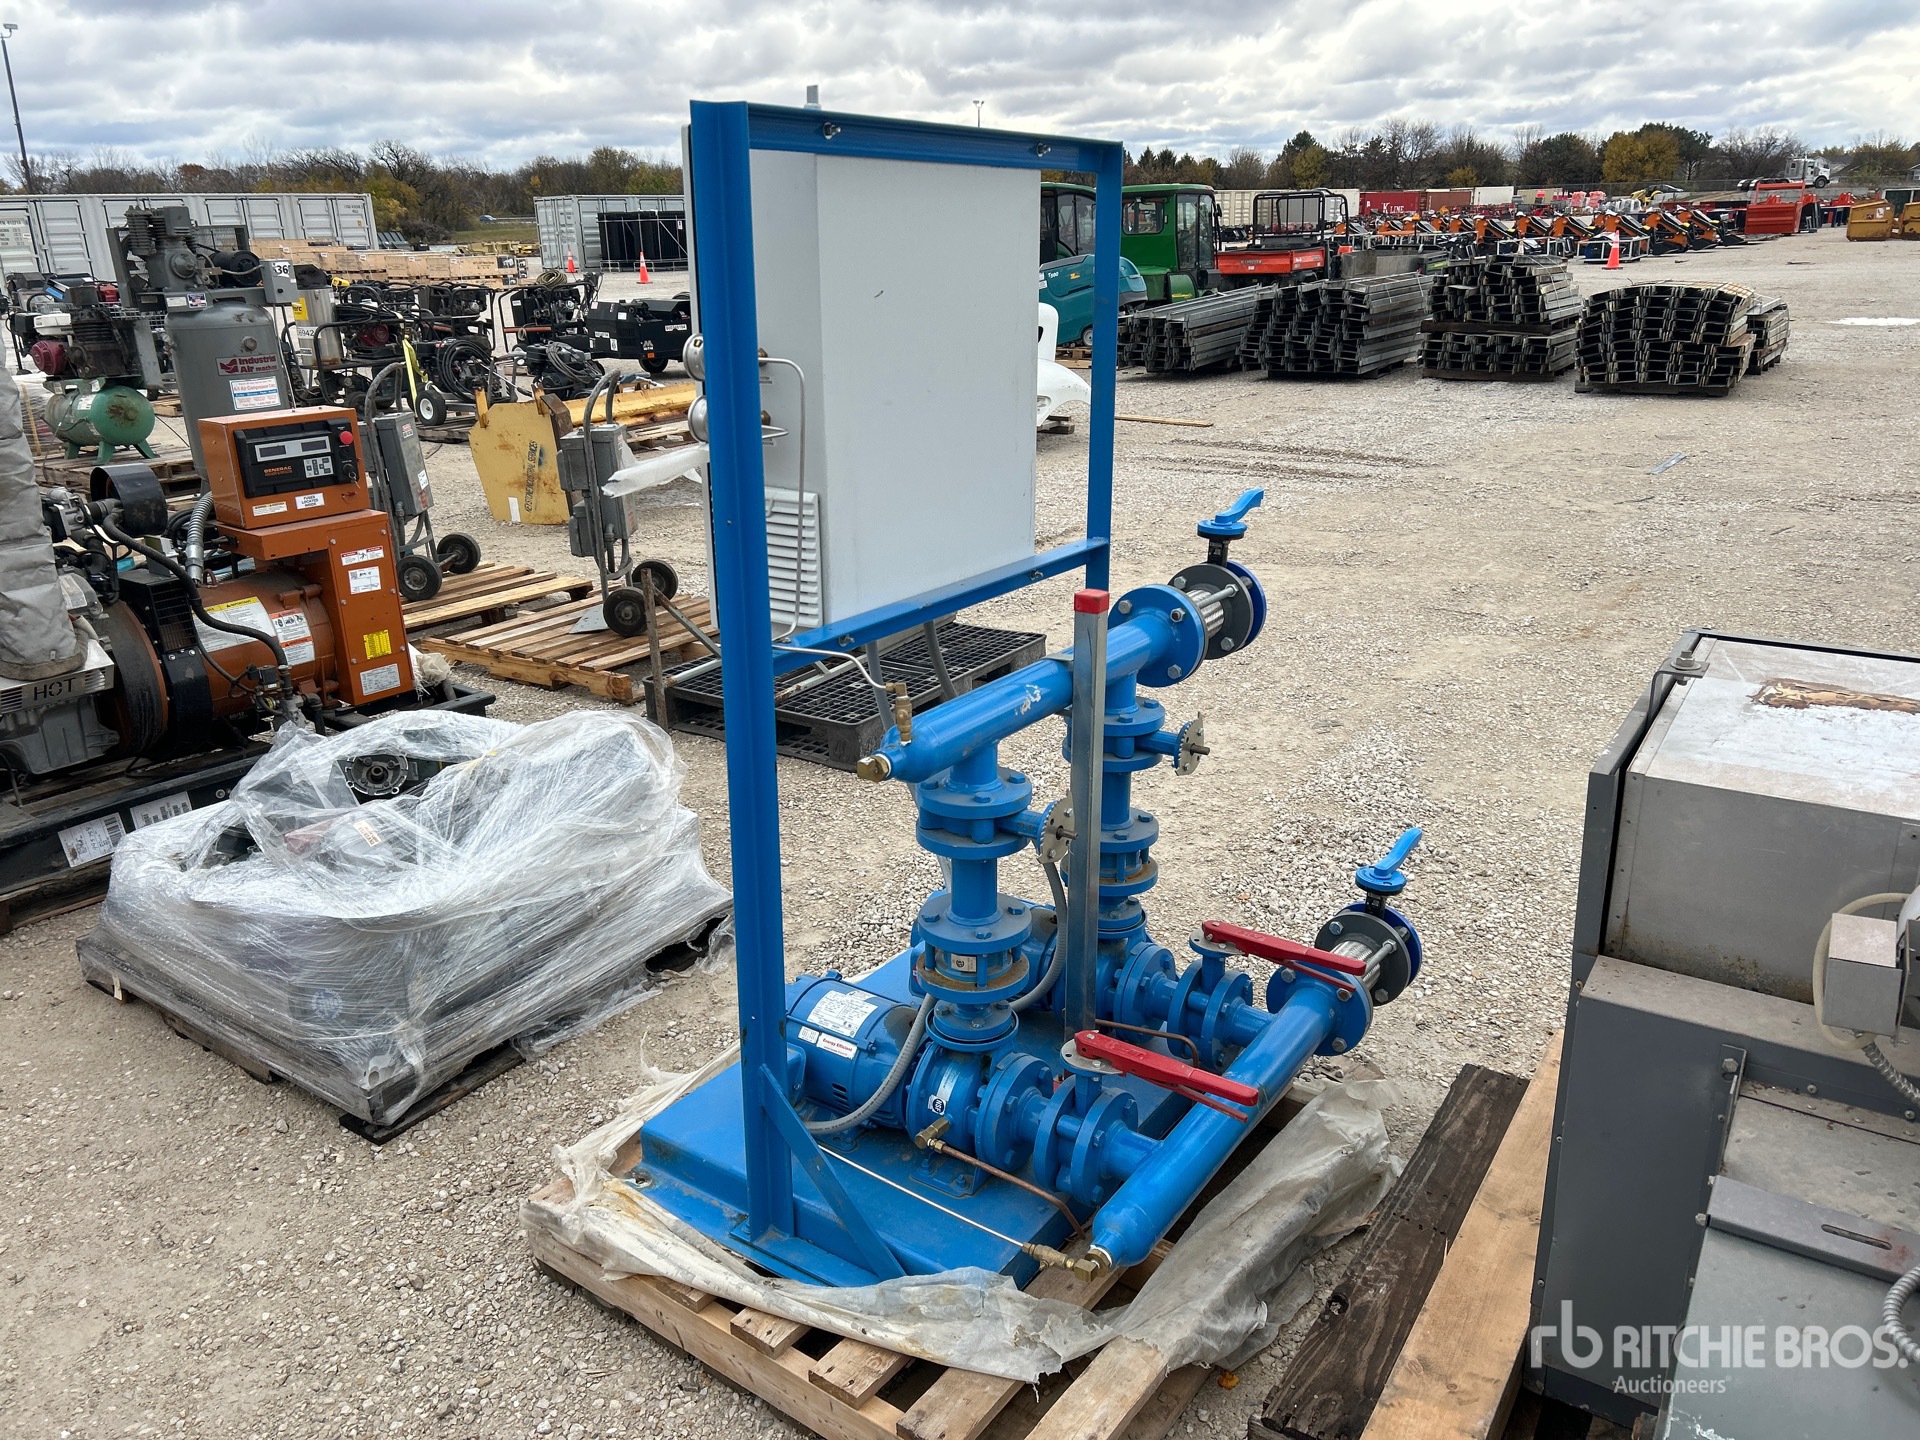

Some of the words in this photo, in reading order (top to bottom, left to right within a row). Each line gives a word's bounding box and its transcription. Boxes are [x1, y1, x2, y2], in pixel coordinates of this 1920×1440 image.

[240, 365, 254, 373] Air
[264, 465, 292, 473] GENERAC
[34, 678, 76, 700] HOT
[822, 1038, 837, 1047] Energy
[837, 1042, 853, 1052] Efficient
[935, 1100, 943, 1112] NSF
